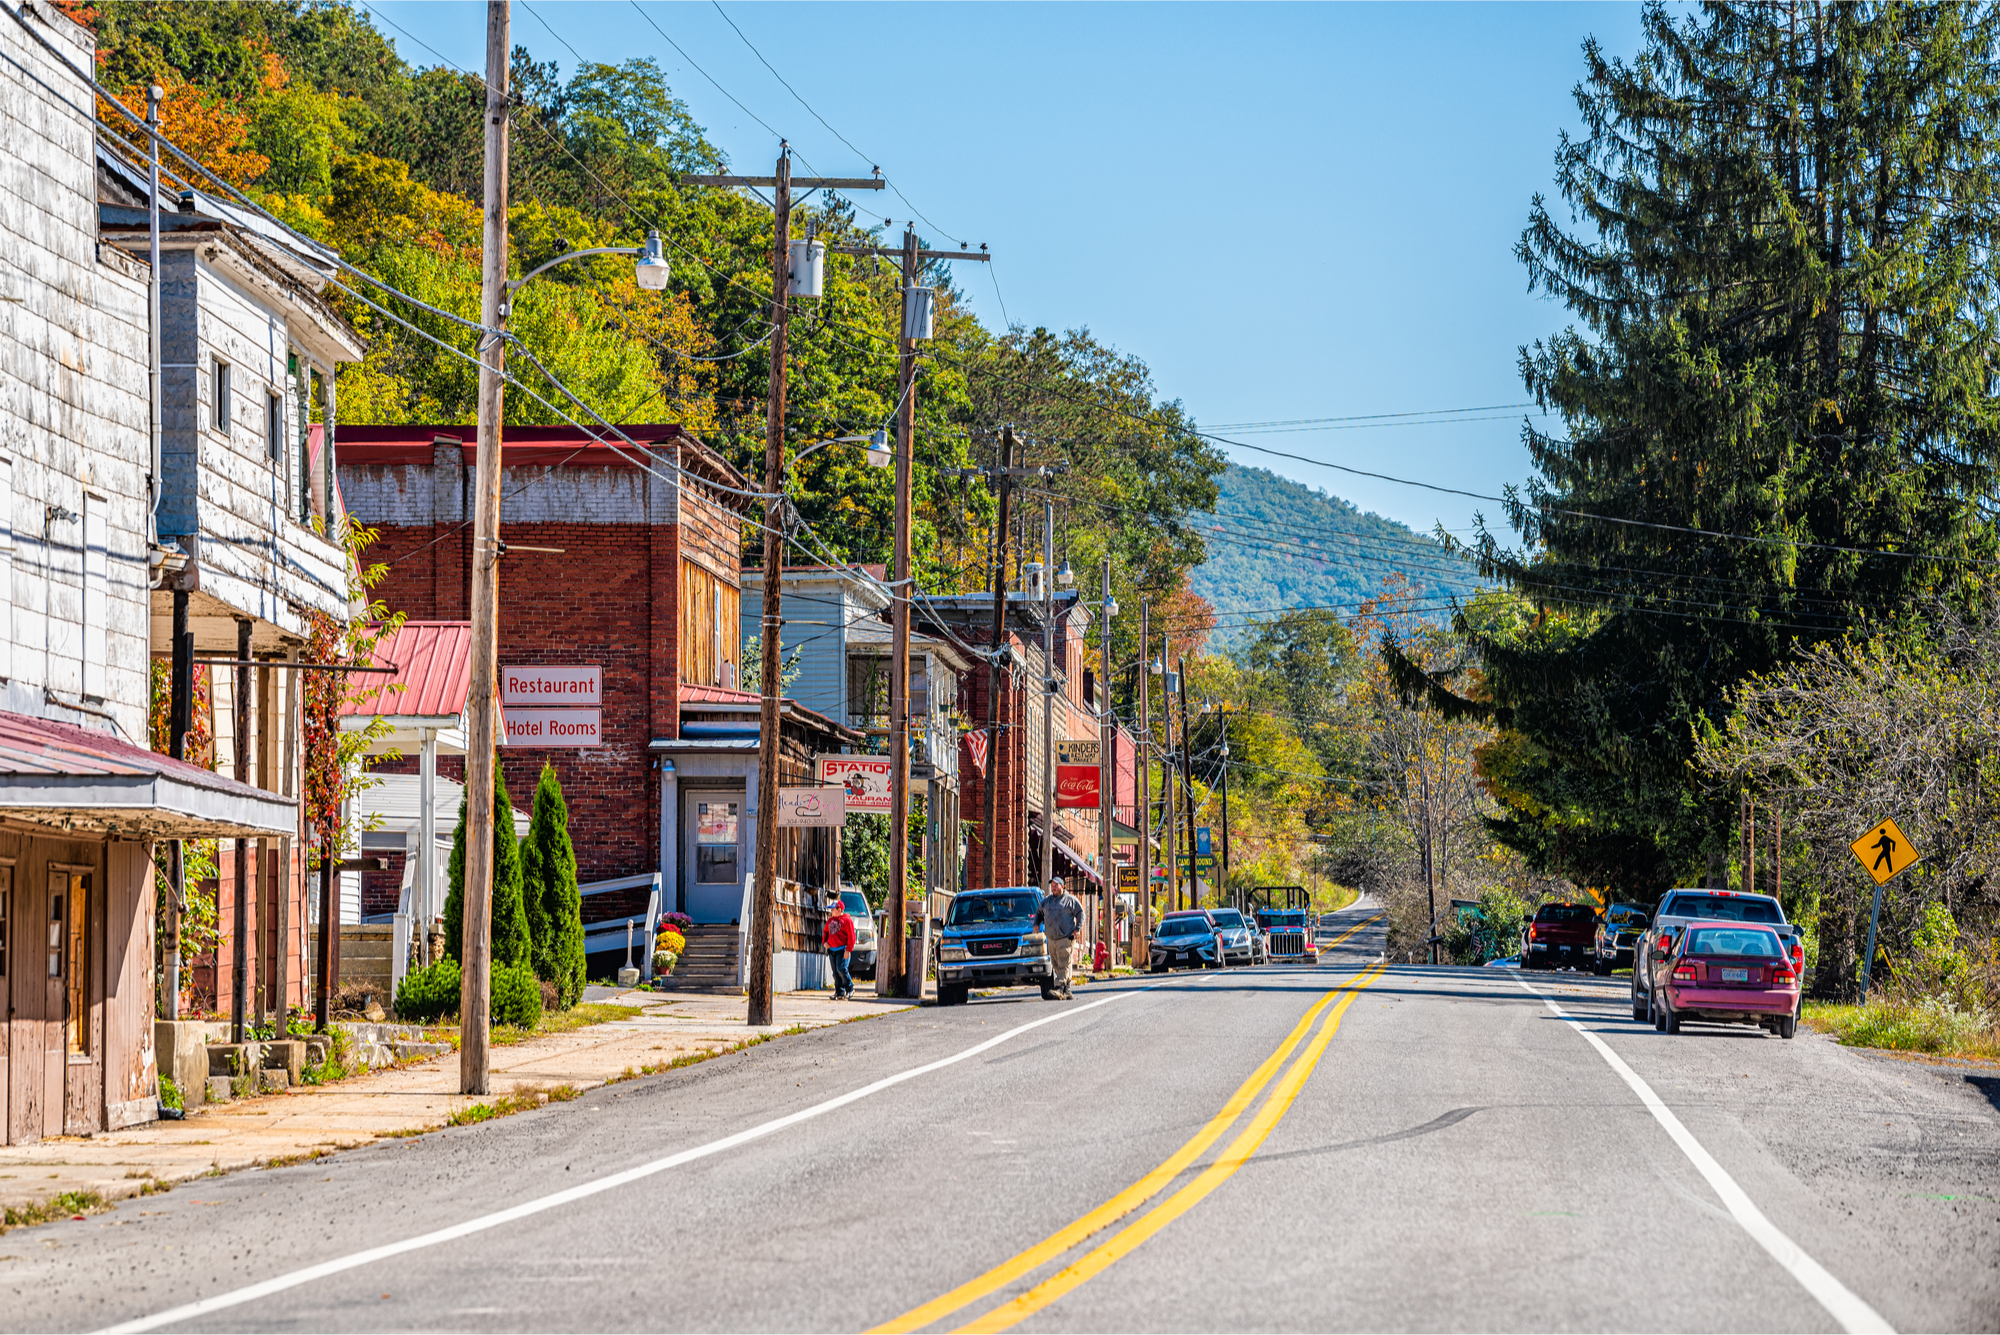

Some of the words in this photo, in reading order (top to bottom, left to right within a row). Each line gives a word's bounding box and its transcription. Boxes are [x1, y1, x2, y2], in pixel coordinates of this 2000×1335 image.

[509, 677, 595, 693] Restaurant
[507, 720, 543, 736] Hotel
[549, 720, 597, 736] Rooms
[1069, 743, 1099, 754] KINDERS
[826, 762, 891, 776] STATIO
[1060, 779, 1096, 791] Coca-Cola
[1177, 857, 1213, 866] CAMOUND
[1121, 874, 1139, 882] Uppe
